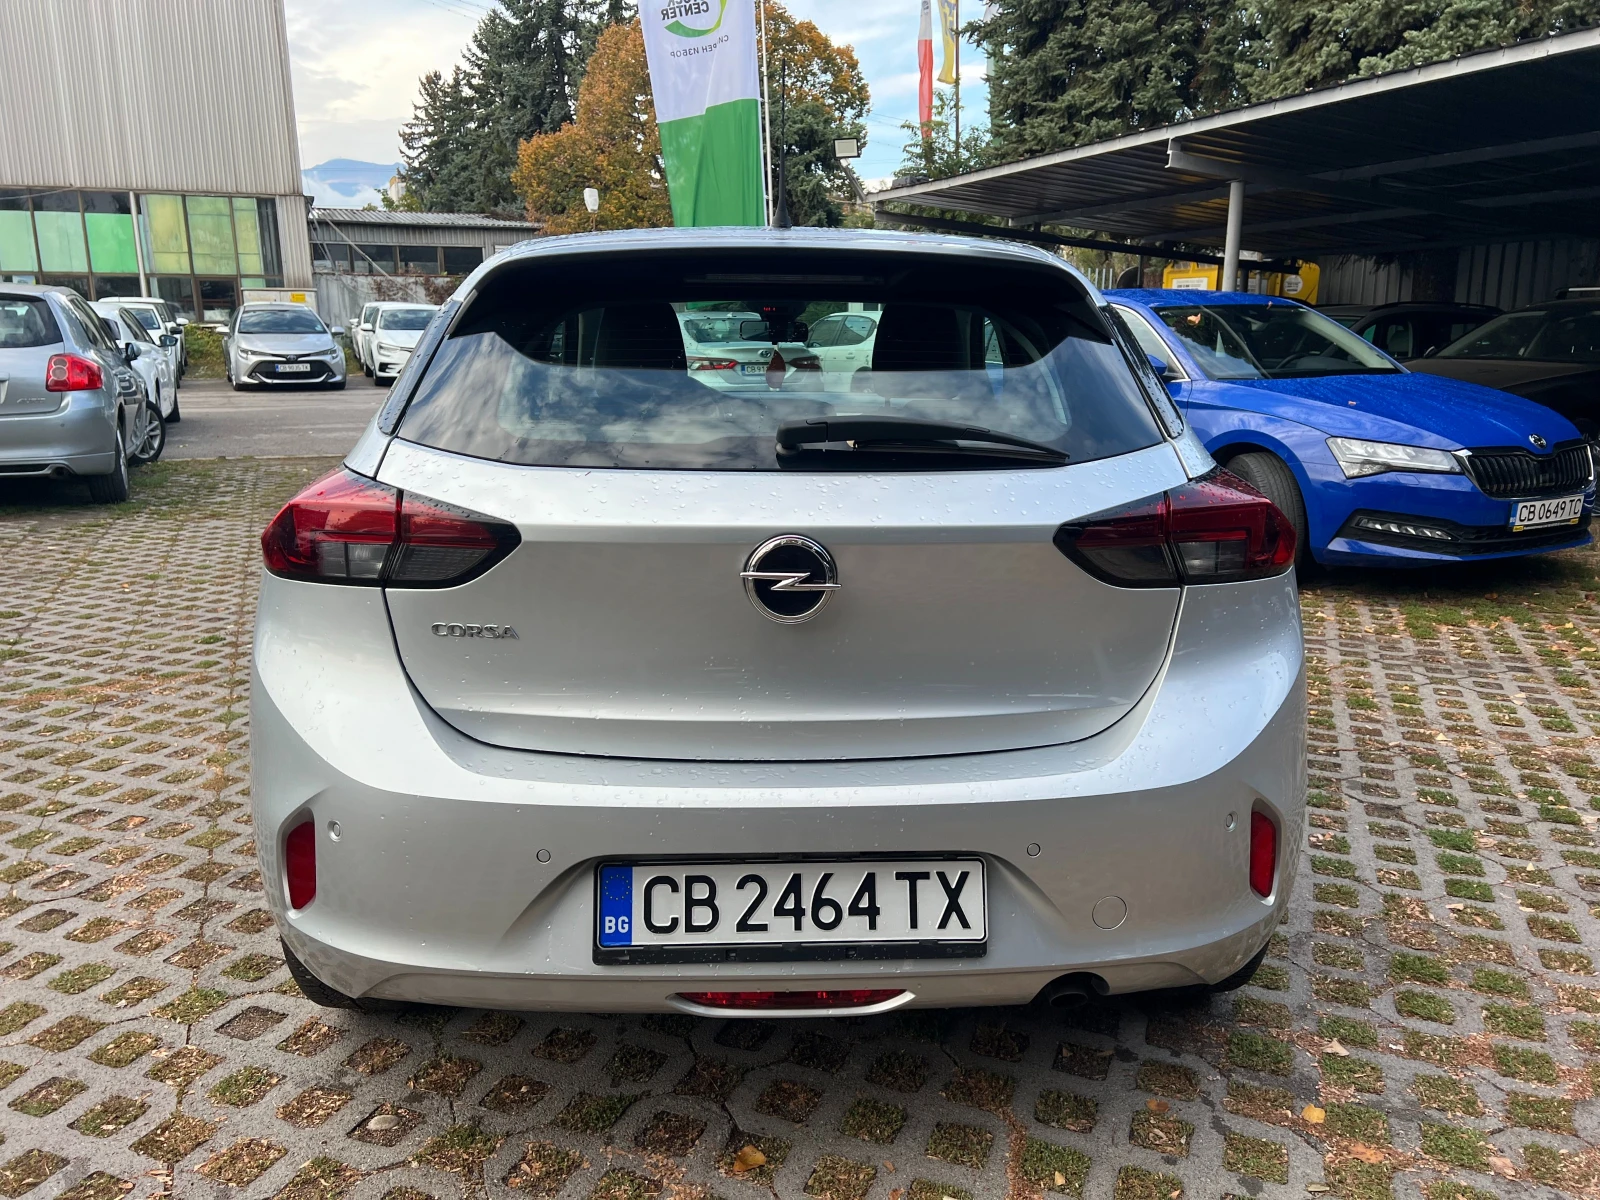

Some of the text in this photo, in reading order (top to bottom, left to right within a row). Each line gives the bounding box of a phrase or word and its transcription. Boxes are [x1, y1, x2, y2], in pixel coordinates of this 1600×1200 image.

[1519, 499, 1581, 522] CB 0649 TC
[431, 622, 520, 640] CORSA
[643, 870, 972, 935] CB 2464 TX
[604, 916, 629, 934] BG
